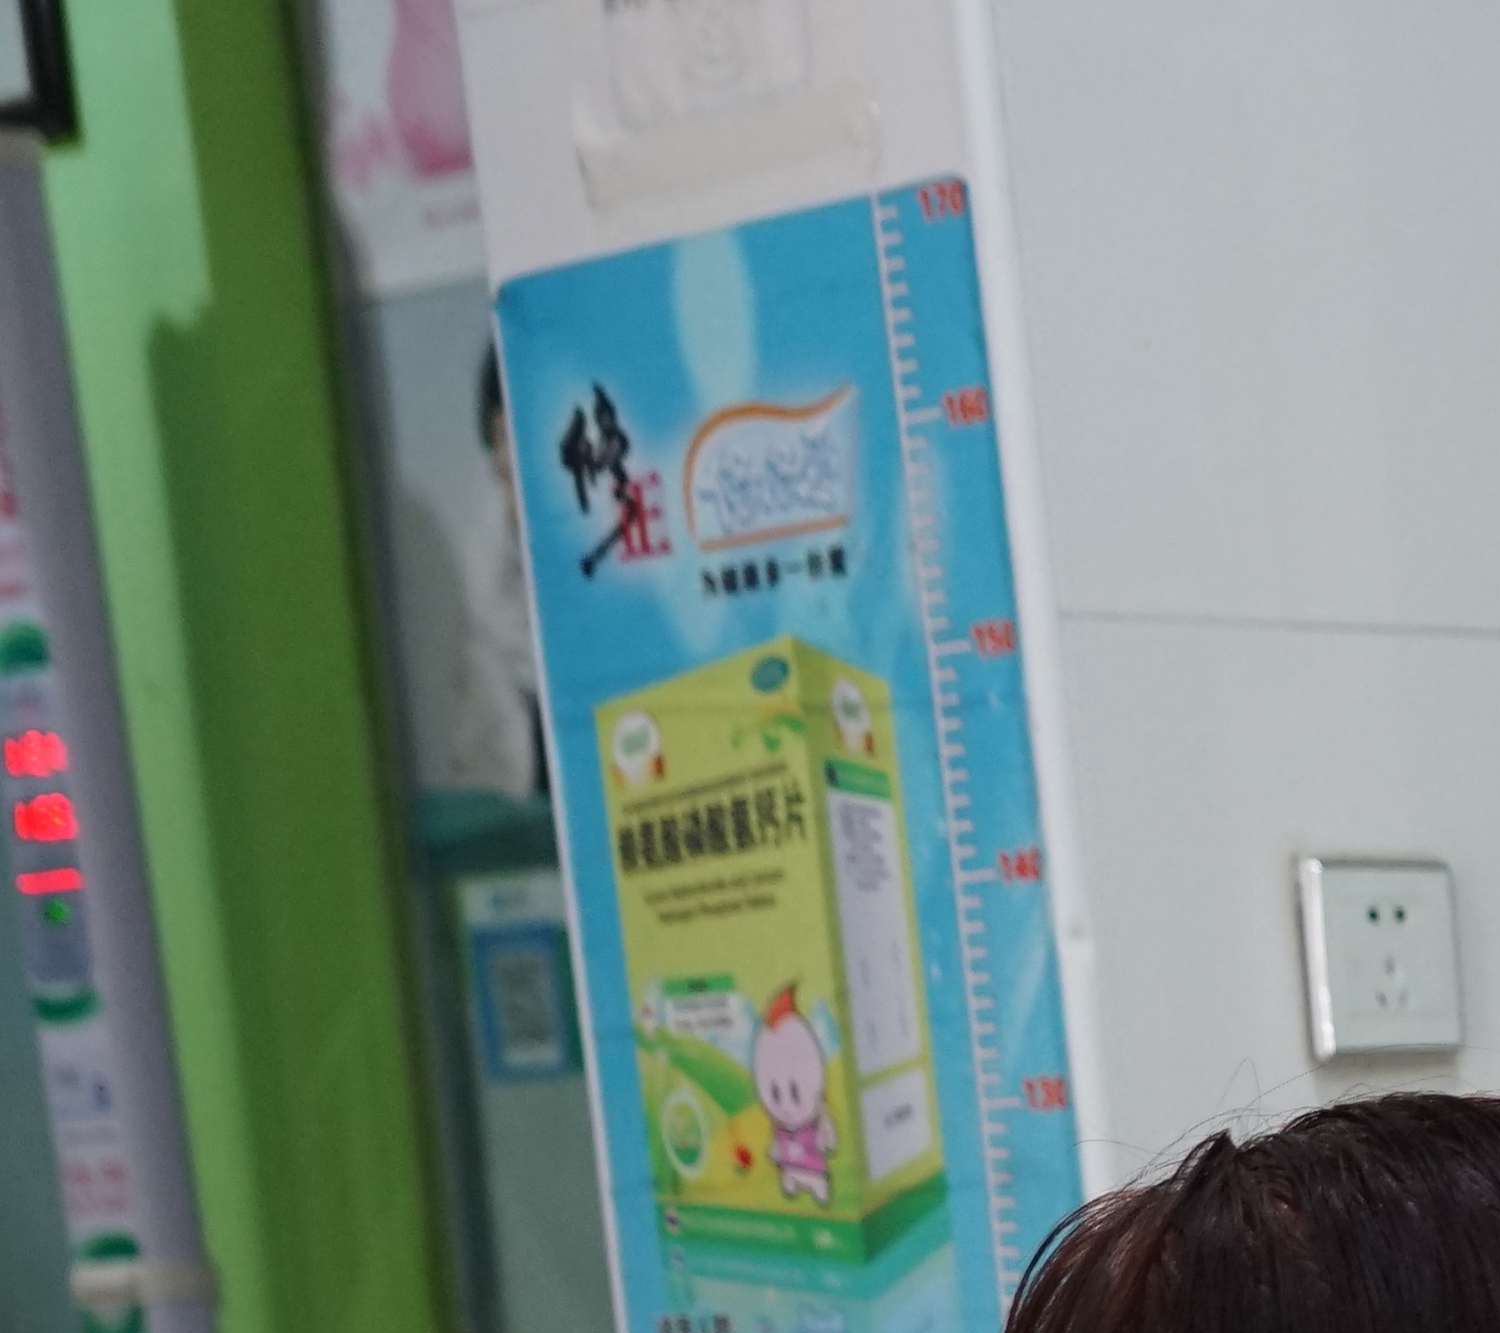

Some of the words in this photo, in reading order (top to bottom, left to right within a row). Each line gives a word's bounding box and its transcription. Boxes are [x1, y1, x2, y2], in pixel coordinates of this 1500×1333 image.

[917, 180, 966, 222] 170
[942, 384, 990, 428] 160
[970, 620, 1016, 659] 150
[997, 846, 1043, 884] 140
[1023, 1077, 1069, 1112] 130
